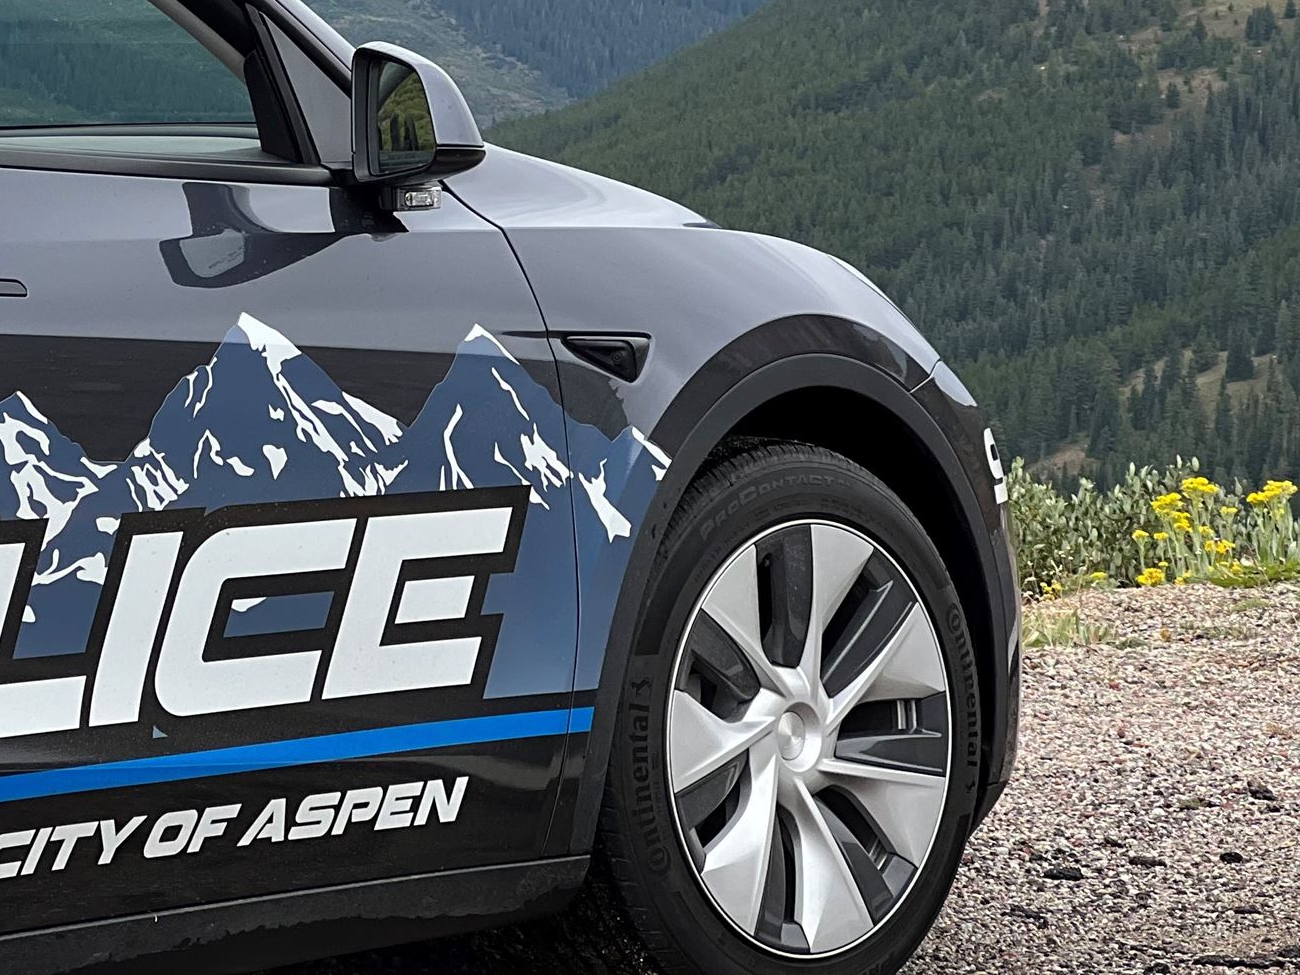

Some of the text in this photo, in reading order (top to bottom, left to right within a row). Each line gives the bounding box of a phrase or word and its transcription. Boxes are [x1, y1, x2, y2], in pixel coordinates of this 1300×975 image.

[143, 804, 242, 858] OF
[237, 776, 469, 846] ASPEN
[627, 701, 671, 877] Continental
